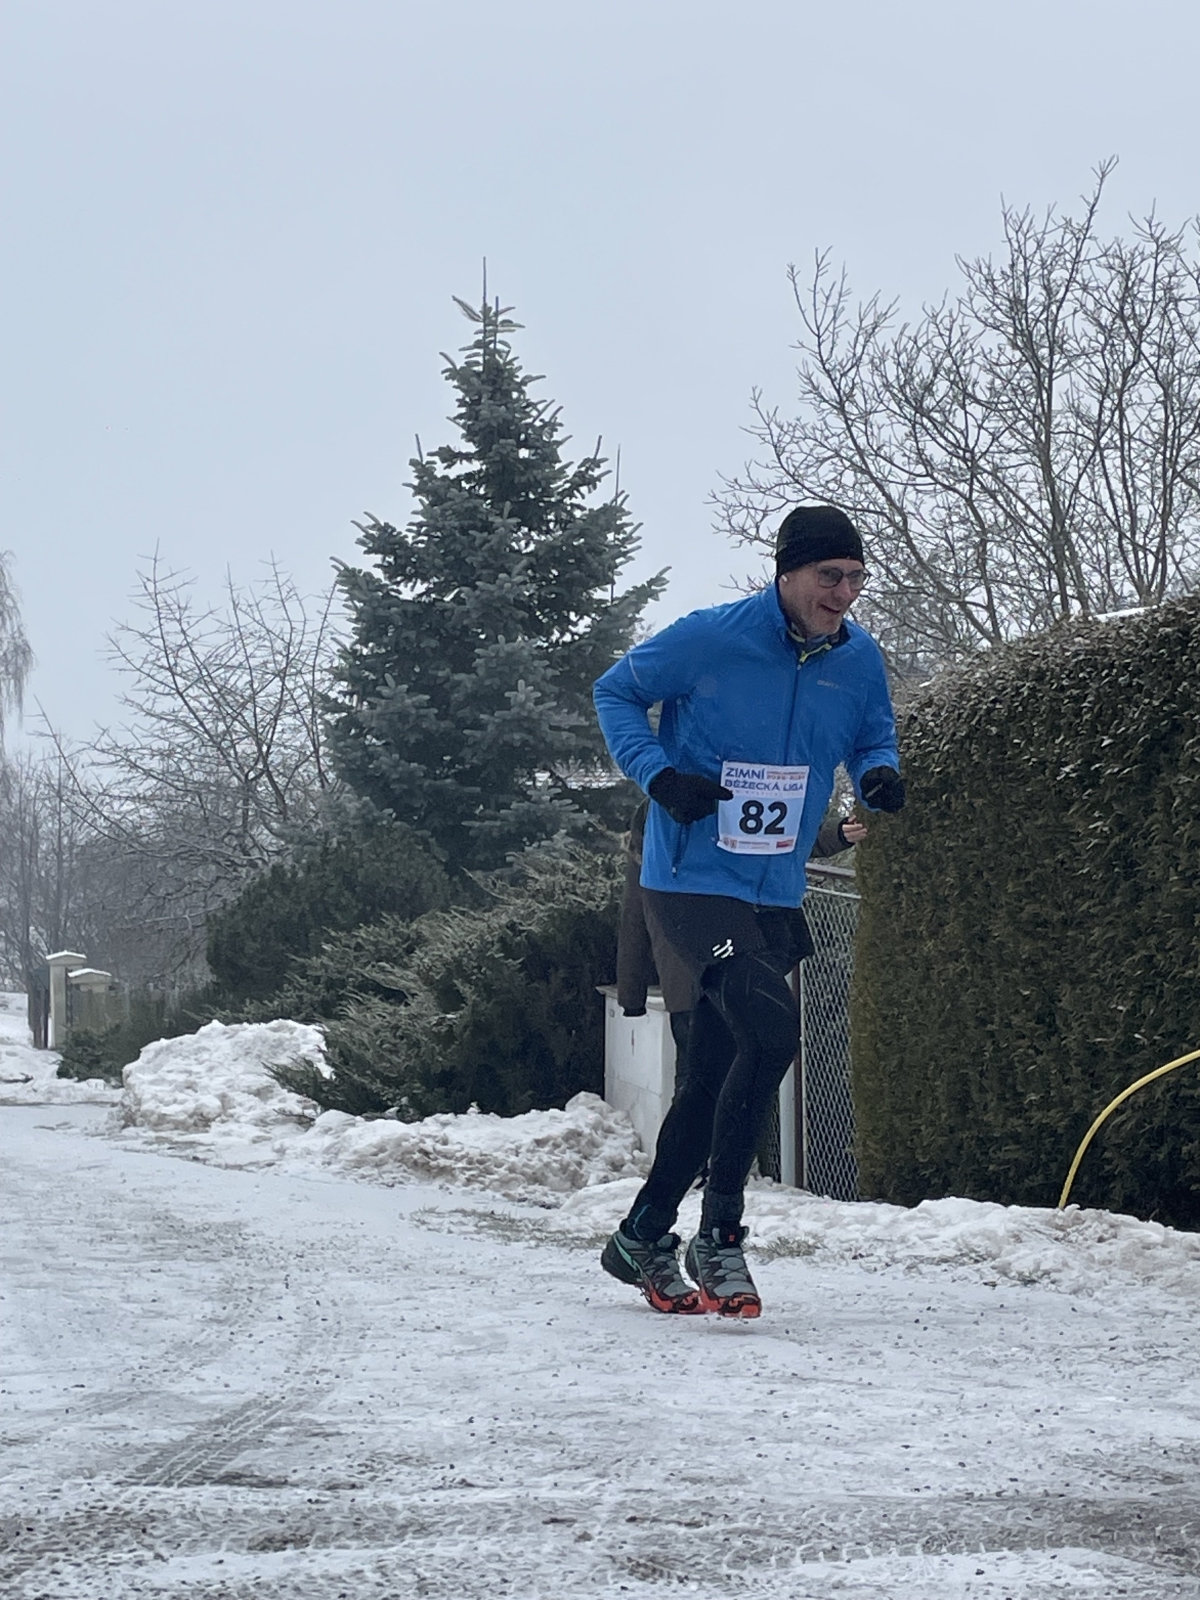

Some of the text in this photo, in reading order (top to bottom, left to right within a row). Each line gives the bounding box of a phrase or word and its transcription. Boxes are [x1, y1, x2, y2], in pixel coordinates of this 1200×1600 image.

[725, 767, 765, 780] ZIMNÍ
[783, 783, 804, 791] LIGA
[739, 800, 787, 835] 82
